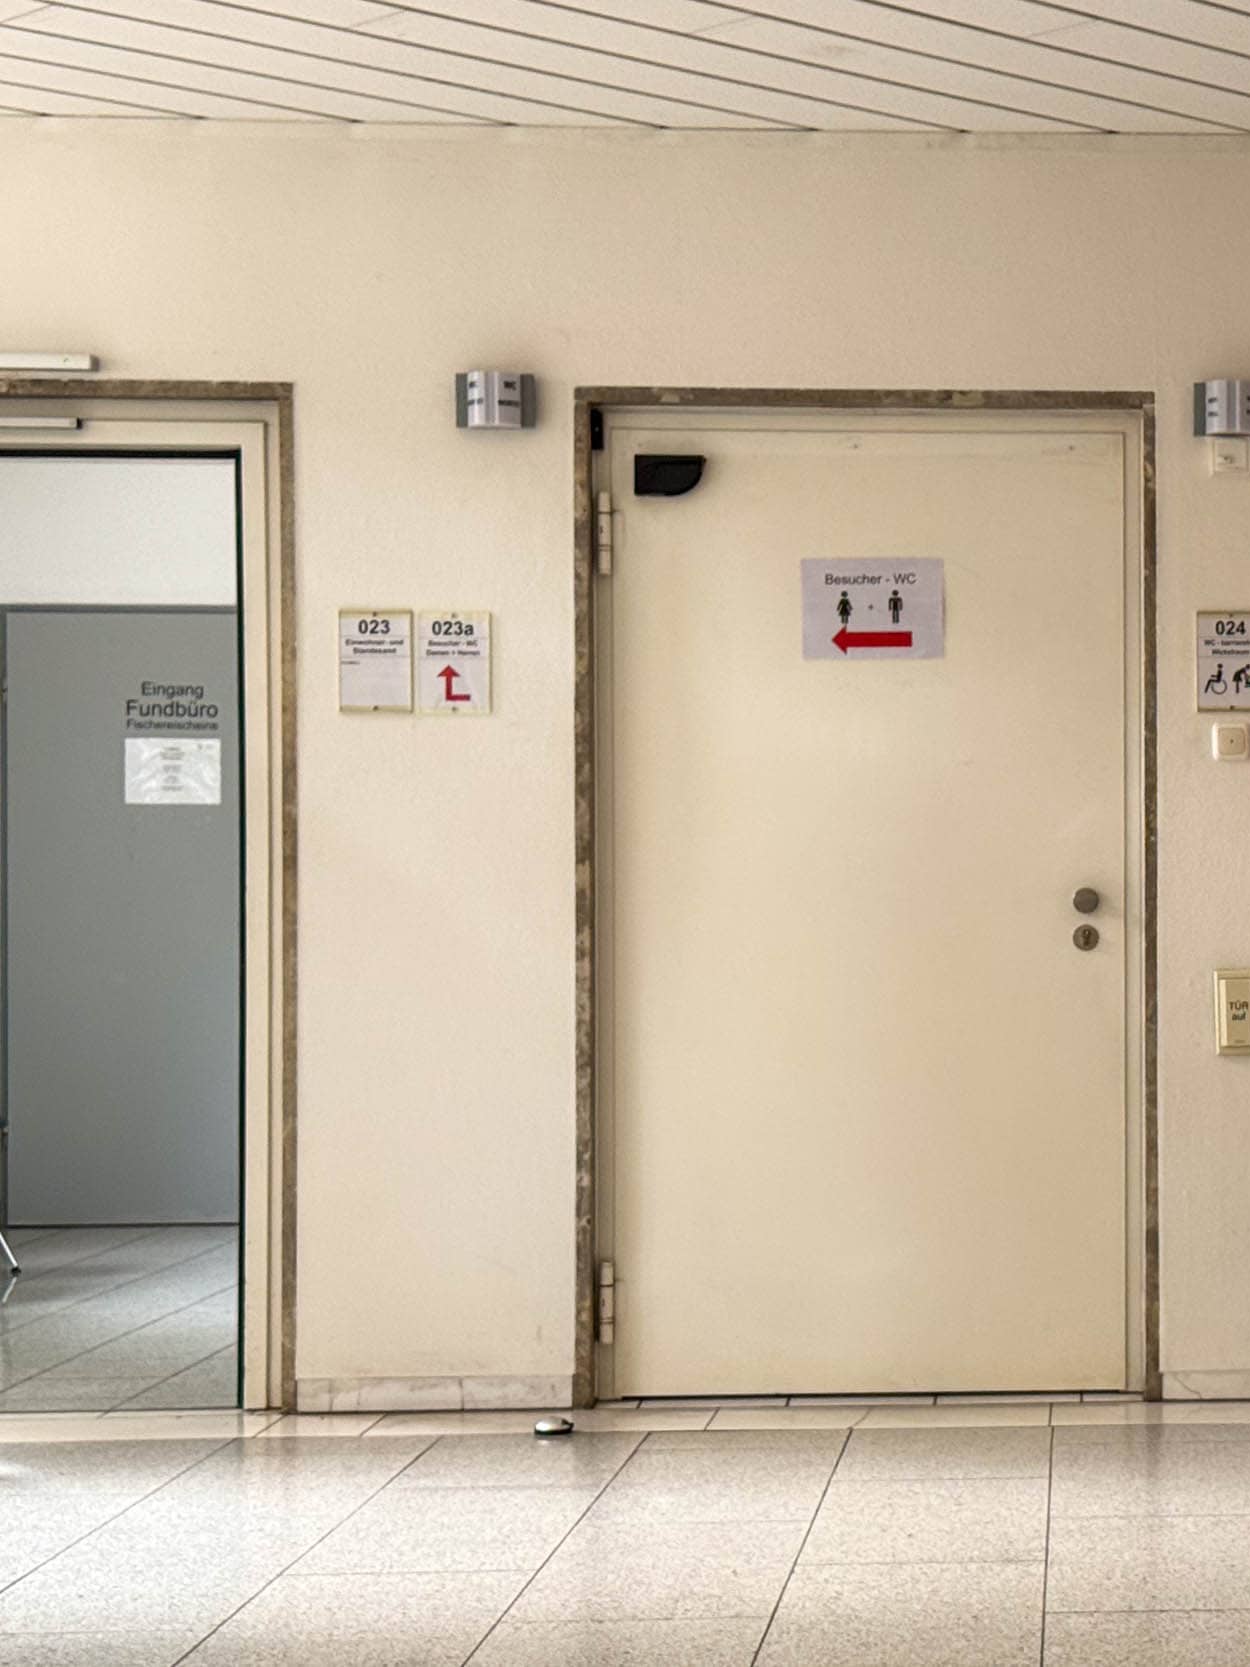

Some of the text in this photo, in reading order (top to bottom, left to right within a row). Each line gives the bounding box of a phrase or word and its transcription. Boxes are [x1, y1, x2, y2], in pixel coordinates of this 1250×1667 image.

[824, 573, 882, 586] Besucher
[893, 572, 917, 585] WC
[358, 619, 391, 634] 023
[431, 620, 475, 636] 023a
[1215, 620, 1246, 635] 024
[141, 680, 205, 700] Eingang
[126, 699, 219, 718] Fundbüro
[1229, 1000, 1249, 1010] TÜR
[1231, 1011, 1246, 1021] auf
